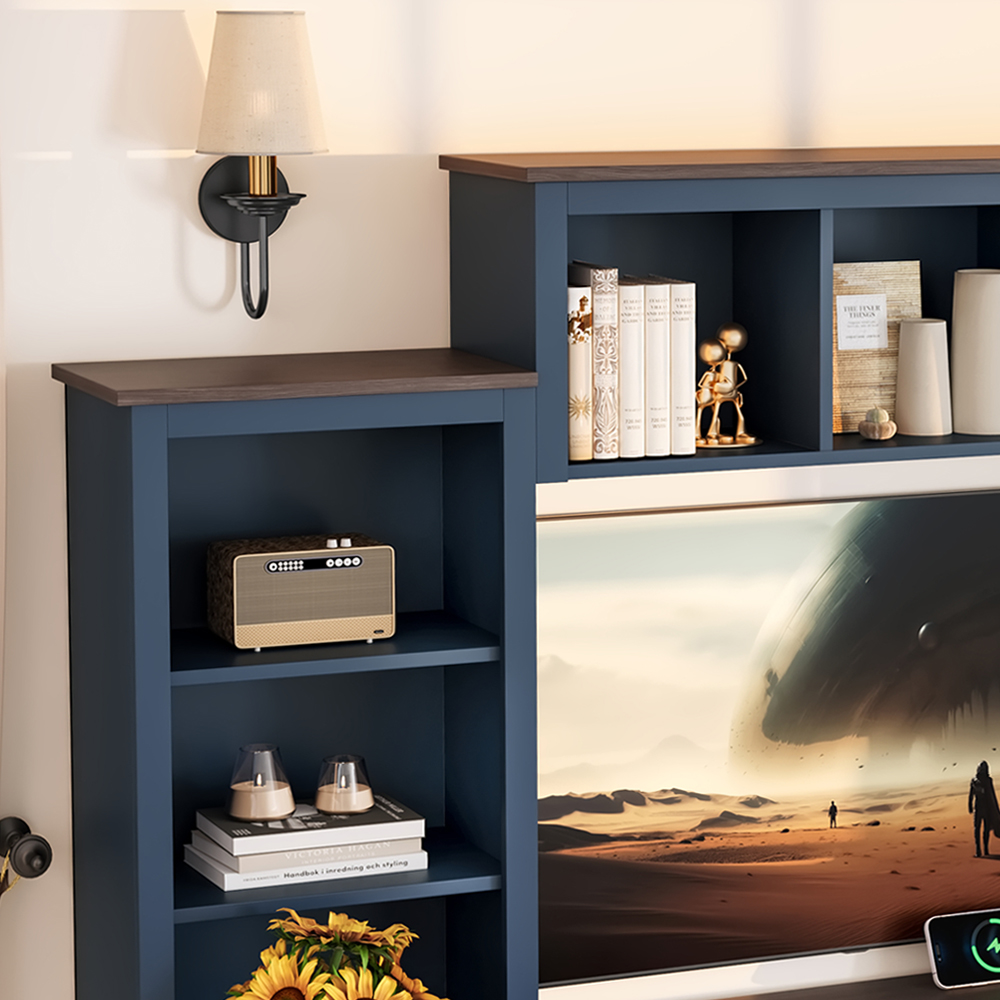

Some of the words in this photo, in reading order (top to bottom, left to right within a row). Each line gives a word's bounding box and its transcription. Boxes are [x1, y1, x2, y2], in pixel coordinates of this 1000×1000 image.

[284, 847, 343, 860] VICTORIA
[348, 841, 392, 852] HAGAN
[284, 869, 319, 879] Handbok
[326, 864, 364, 874] inredning
[382, 860, 408, 868] styling
